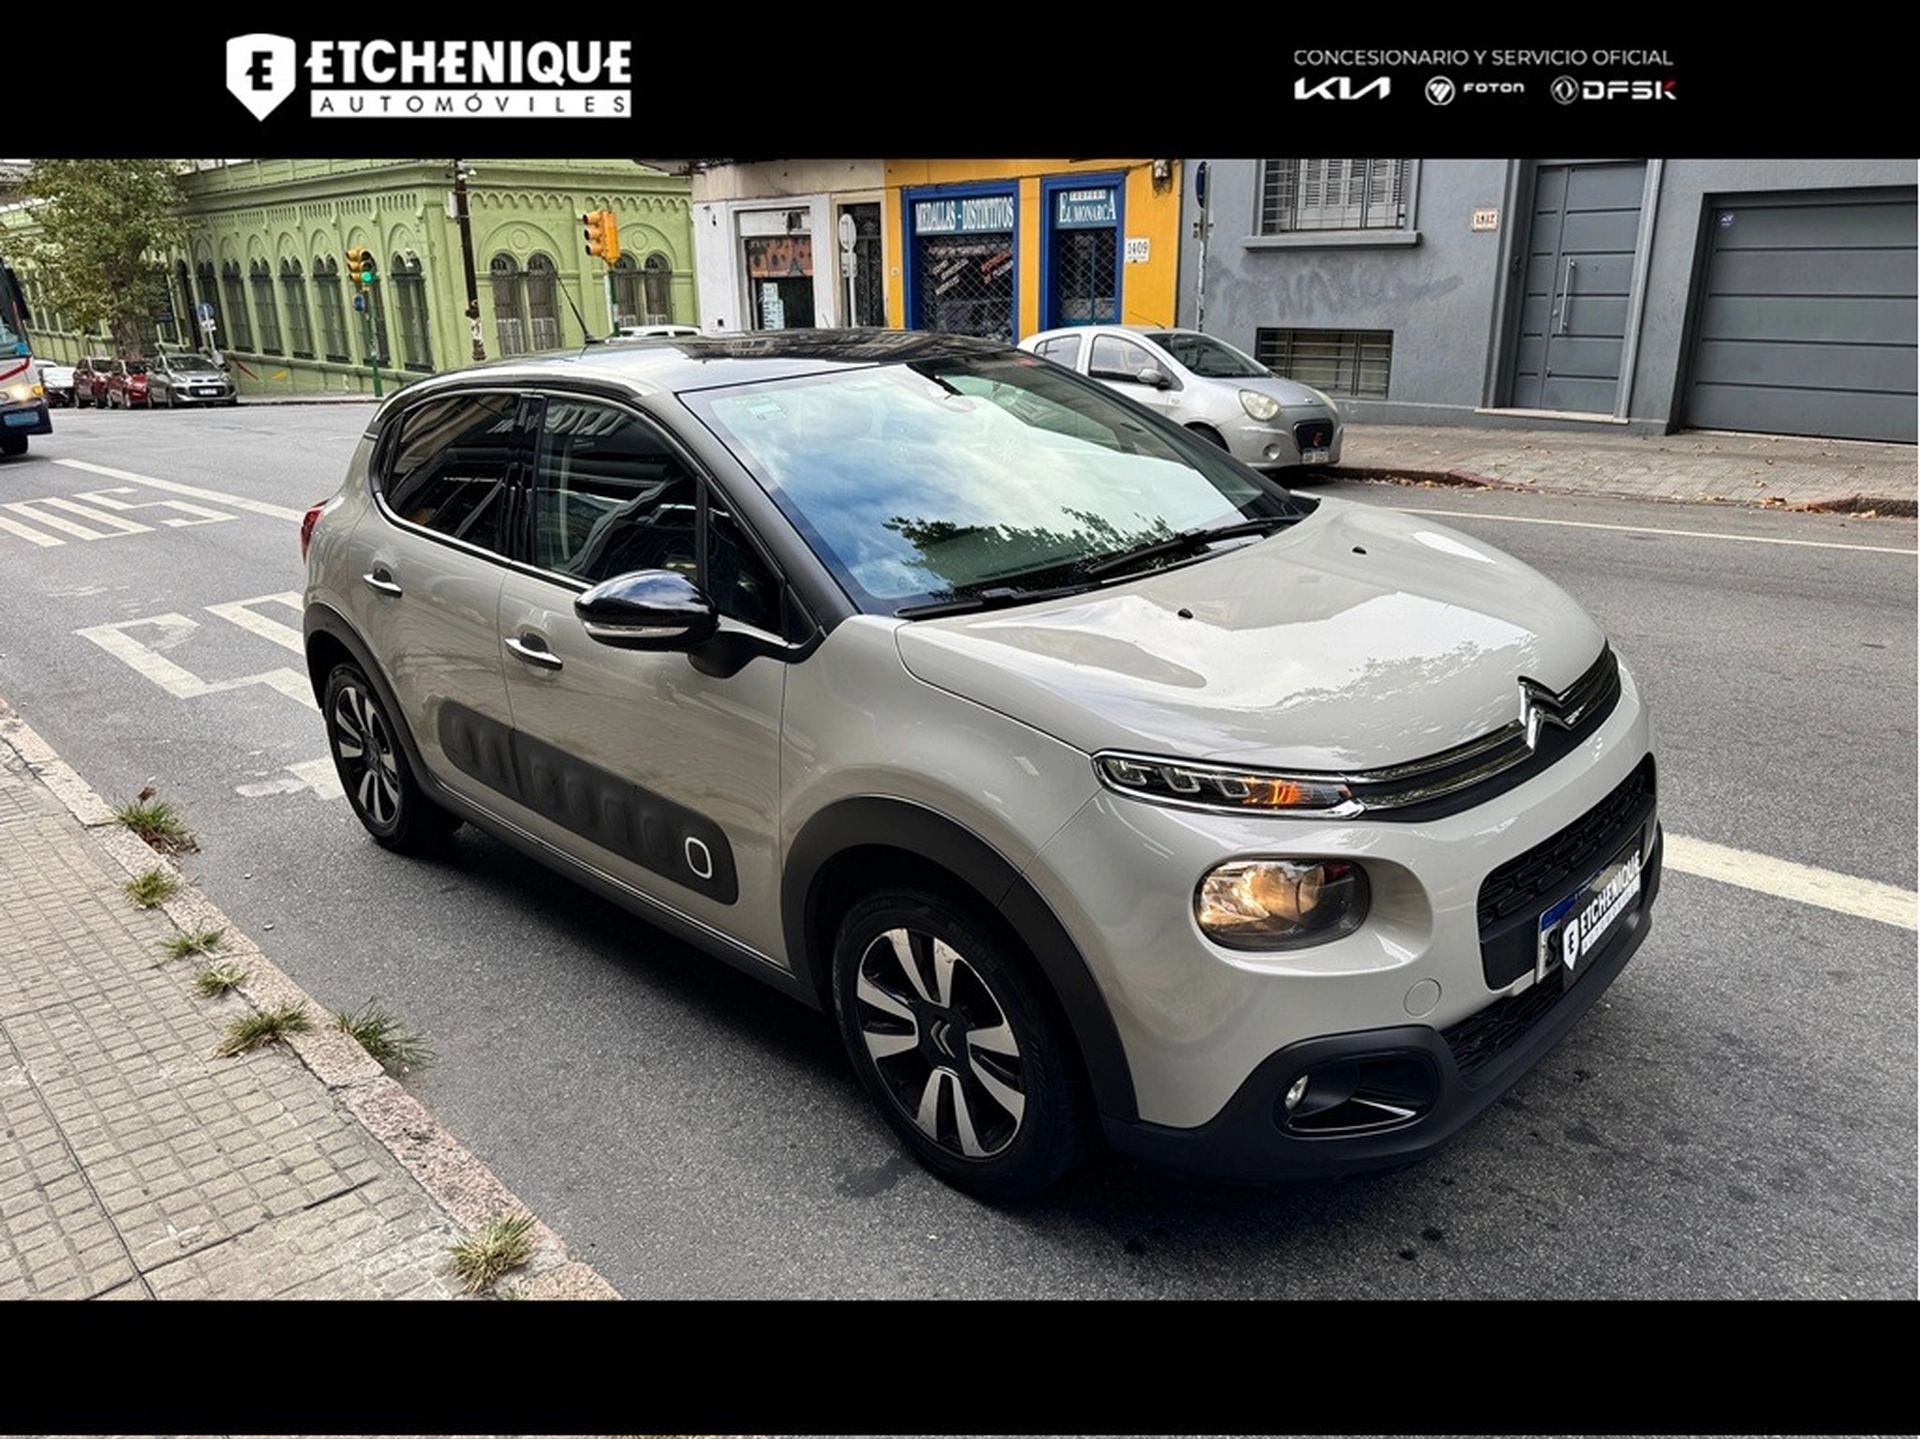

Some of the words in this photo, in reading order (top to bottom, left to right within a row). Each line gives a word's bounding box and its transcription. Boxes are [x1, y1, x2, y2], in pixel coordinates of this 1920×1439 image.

[915, 200, 956, 232] MEDALLAS
[962, 196, 1015, 230] DISTINTIVOS
[1127, 241, 1149, 255] 1409
